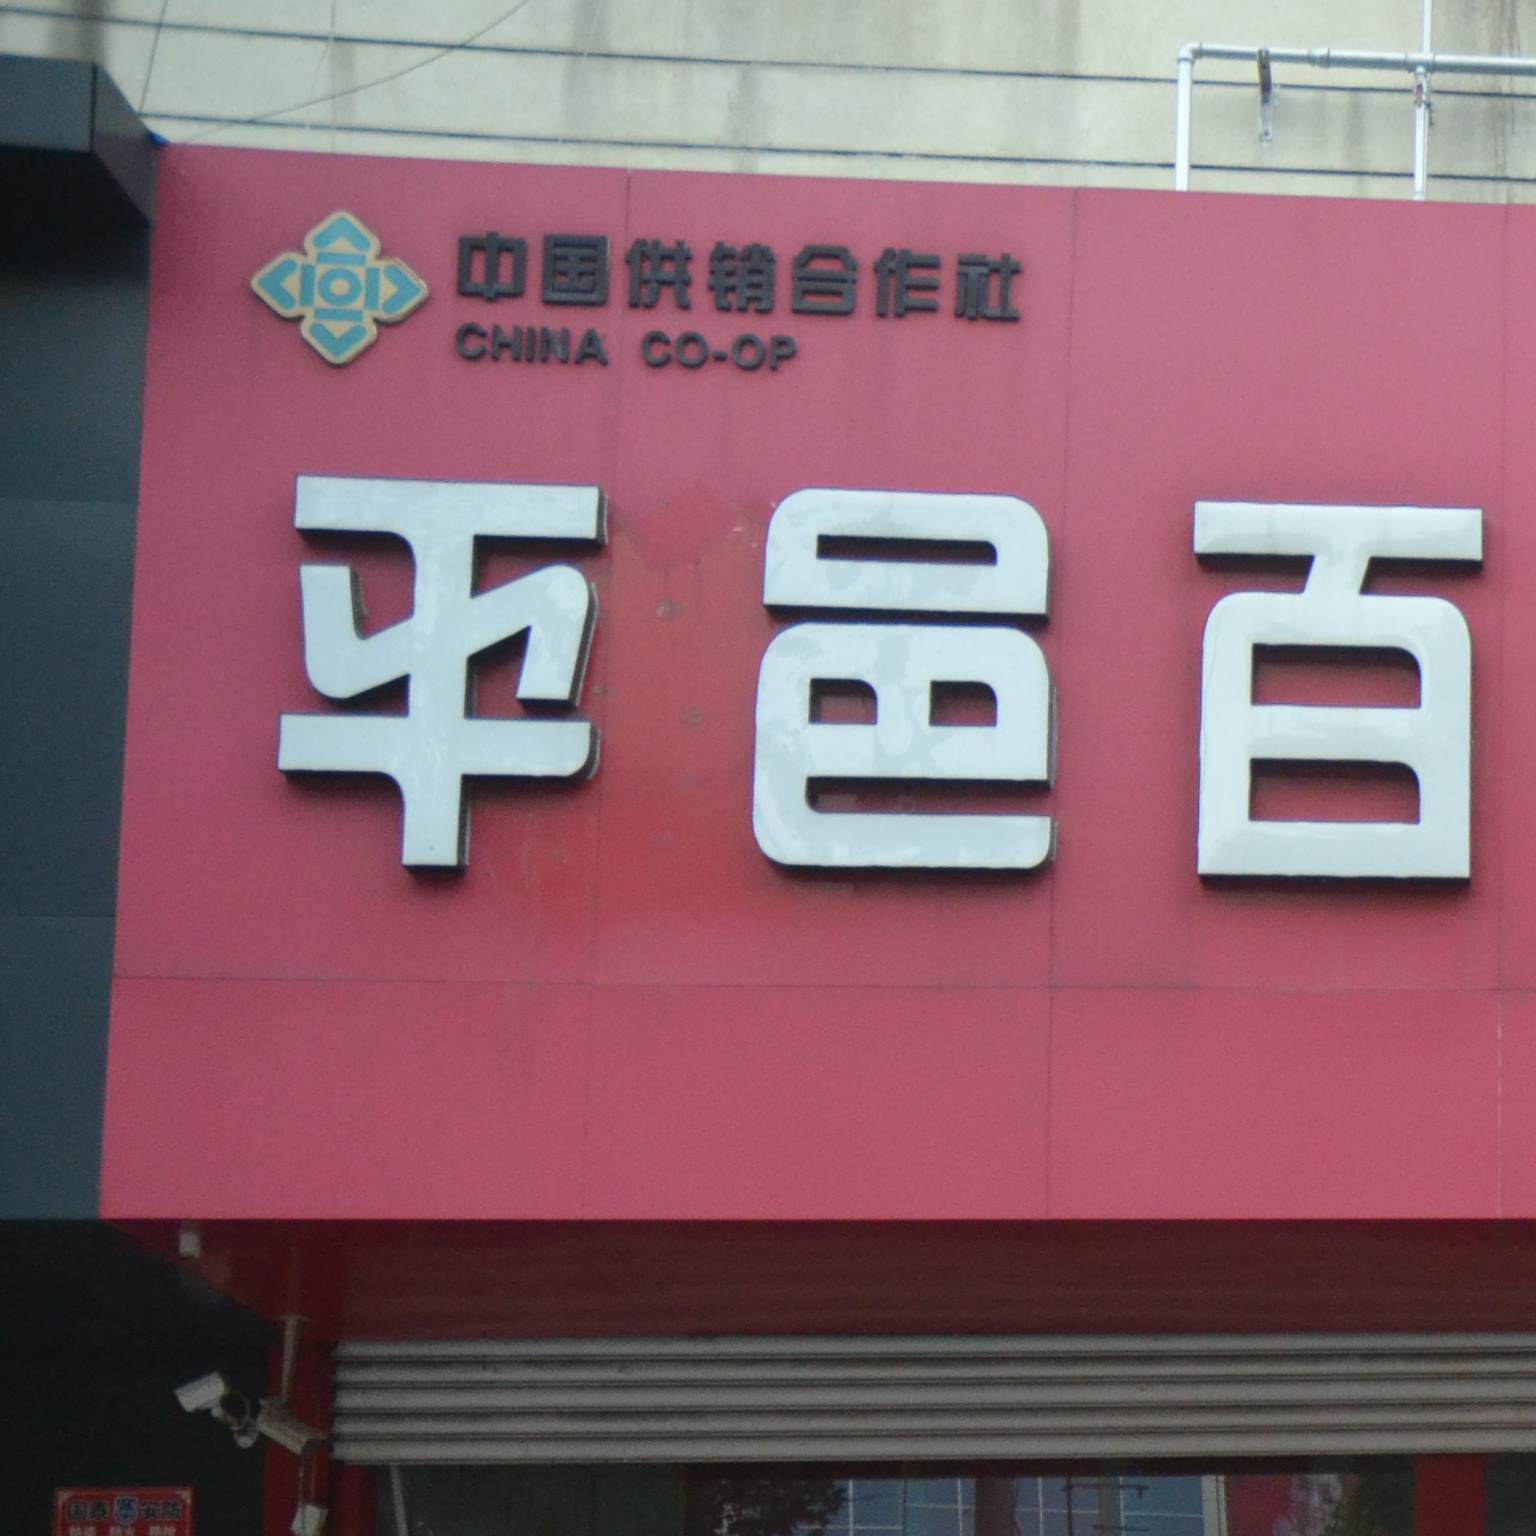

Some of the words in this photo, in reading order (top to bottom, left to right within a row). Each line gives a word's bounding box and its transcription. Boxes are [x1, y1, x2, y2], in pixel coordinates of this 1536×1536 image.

[456, 230, 1022, 323] 中国供销合作社
[454, 322, 609, 366] CHINA
[641, 329, 798, 372] CO-OP
